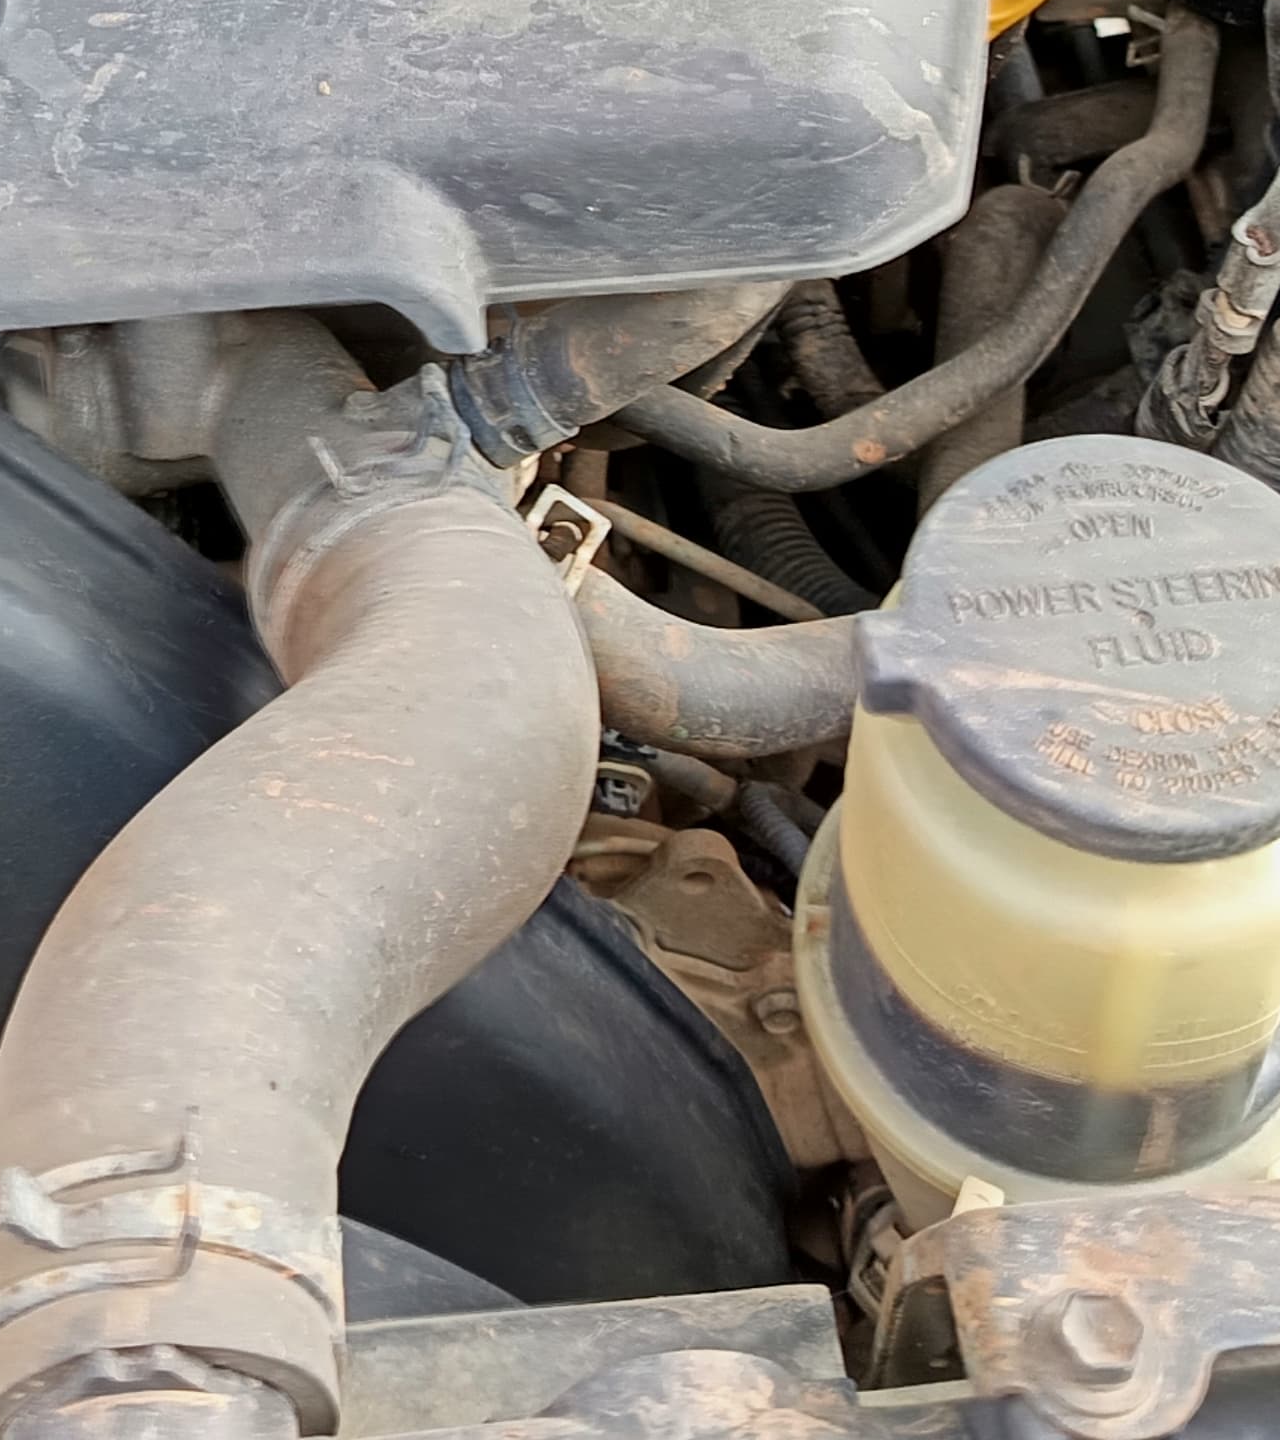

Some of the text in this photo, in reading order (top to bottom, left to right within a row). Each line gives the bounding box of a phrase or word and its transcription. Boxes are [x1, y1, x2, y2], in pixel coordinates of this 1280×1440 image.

[1069, 511, 1157, 541] OPEN
[949, 580, 1103, 624] POWER
[1087, 627, 1223, 669] FLUID
[1128, 697, 1242, 737] CLOSE
